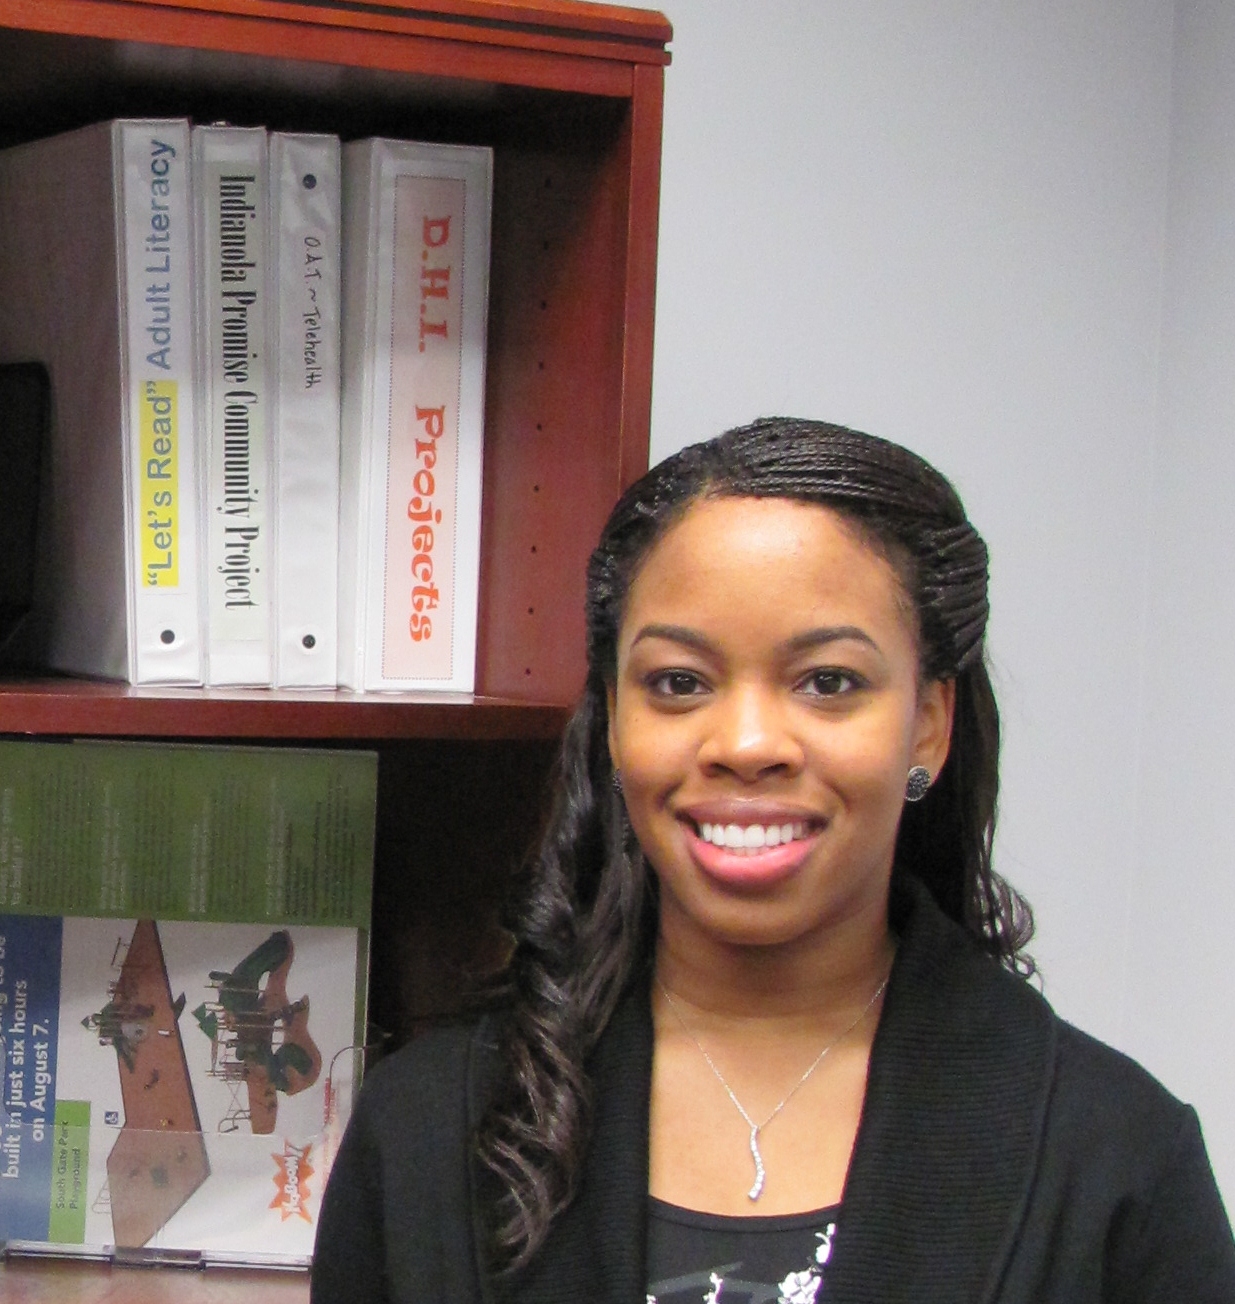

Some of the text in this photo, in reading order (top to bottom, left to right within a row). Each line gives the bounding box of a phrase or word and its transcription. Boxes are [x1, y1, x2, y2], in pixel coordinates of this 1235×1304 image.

[146, 139, 176, 272] Literacy
[146, 282, 170, 370] Adult
[303, 309, 322, 388] Telehealth
[216, 175, 260, 611] Indianola Promise Community Project
[408, 405, 446, 642] Projects
[2, 980, 28, 1178] built in just six hours
[30, 1018, 52, 1142] on August 7.
[56, 1180, 66, 1209] South
